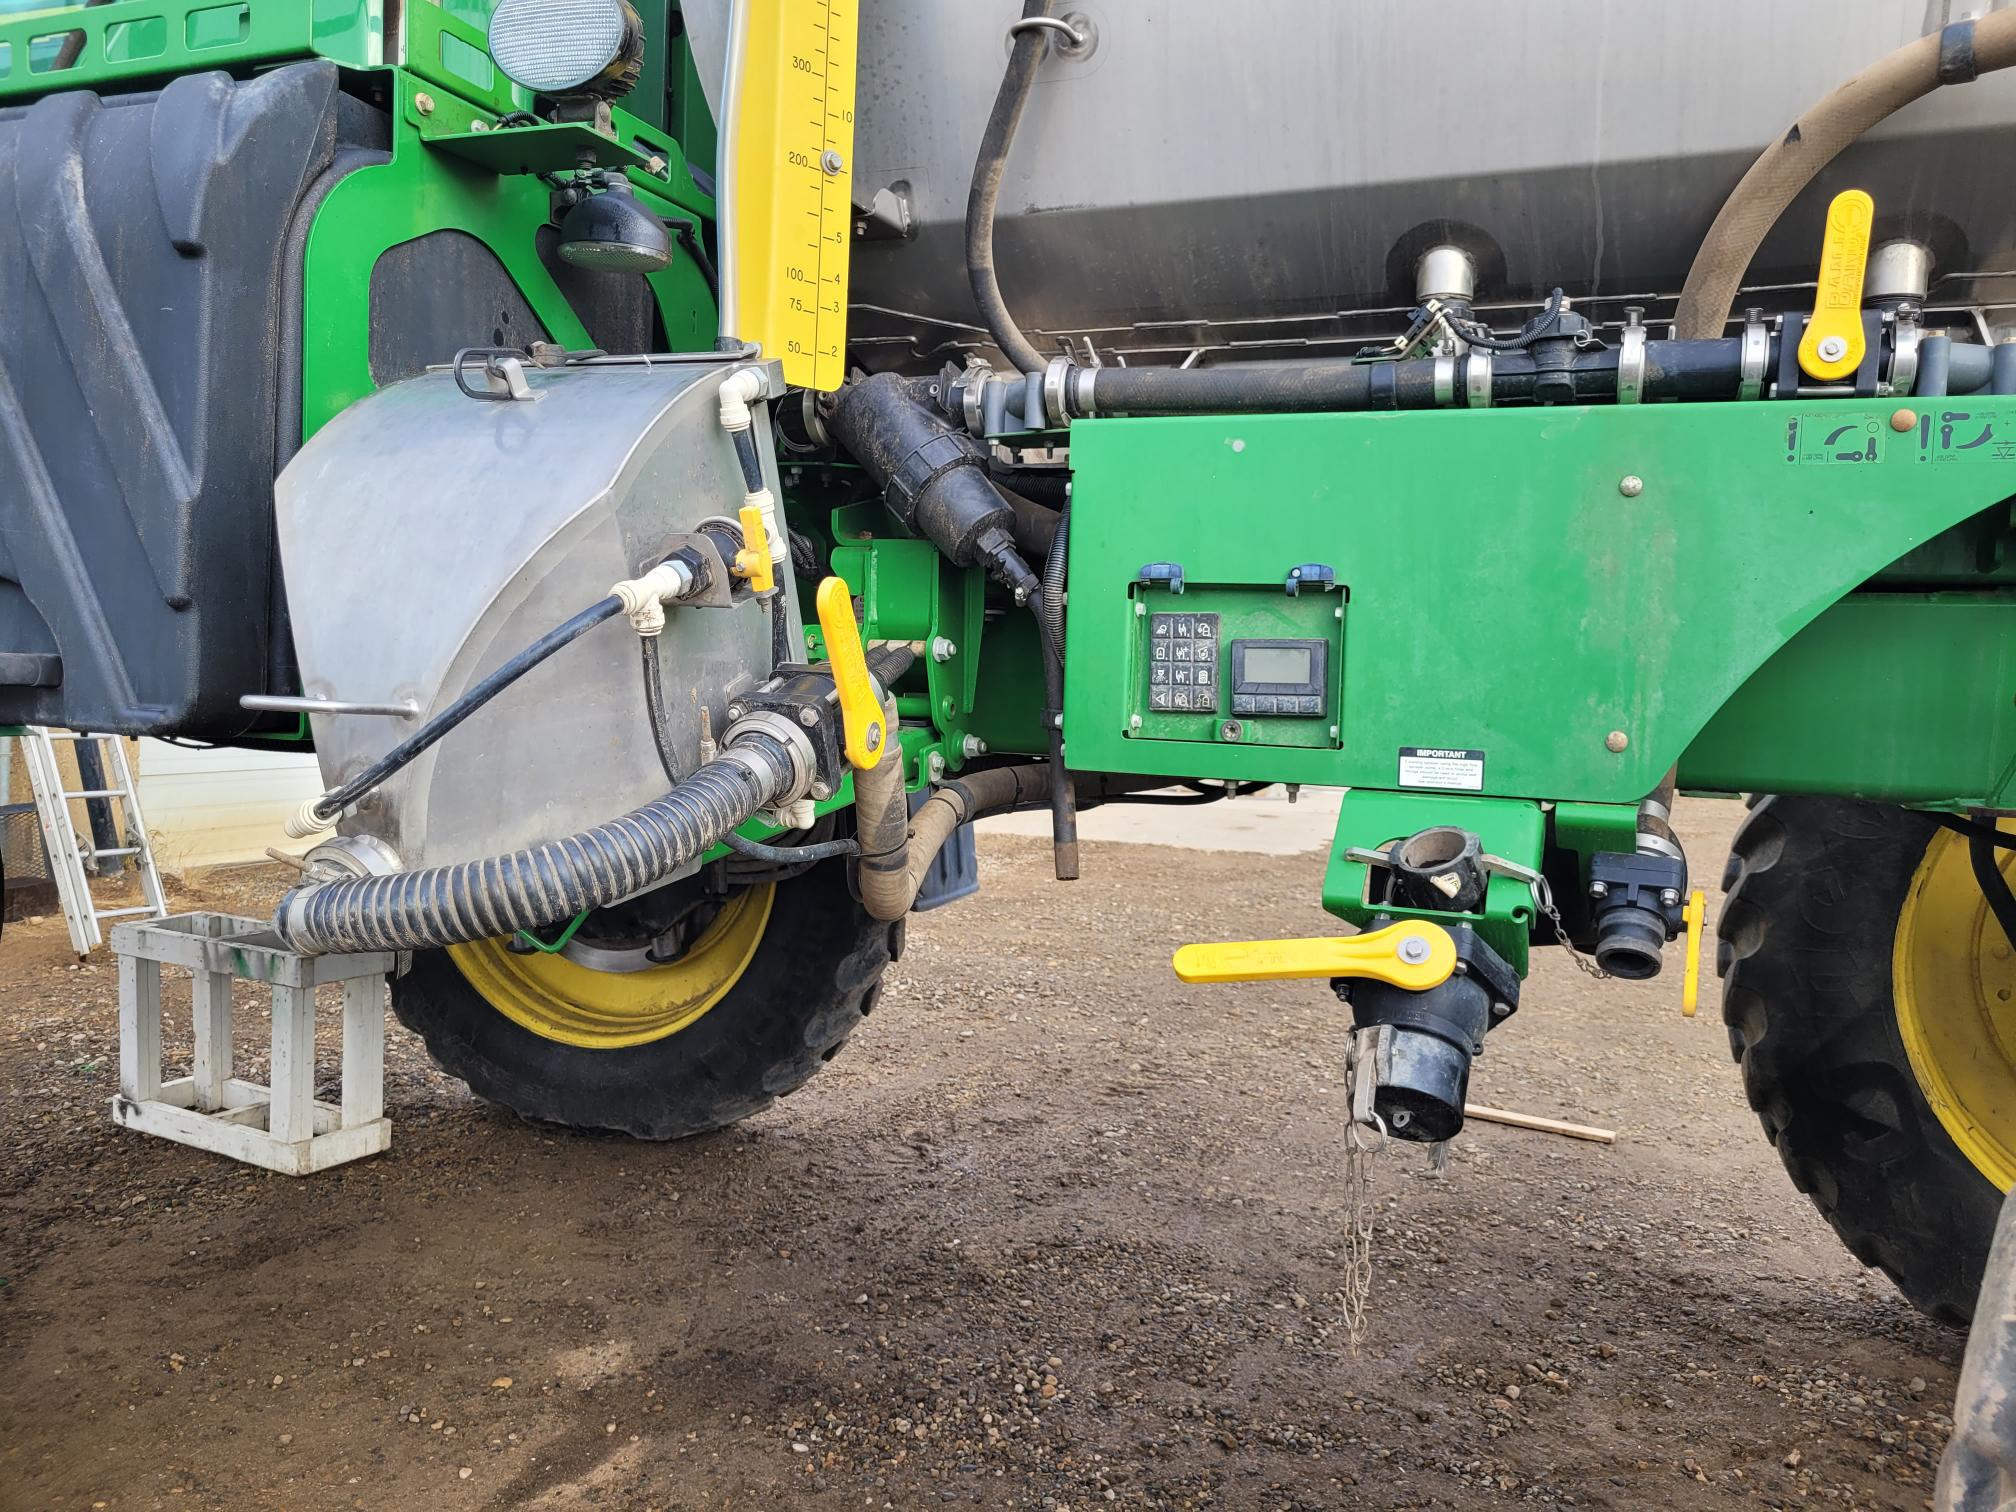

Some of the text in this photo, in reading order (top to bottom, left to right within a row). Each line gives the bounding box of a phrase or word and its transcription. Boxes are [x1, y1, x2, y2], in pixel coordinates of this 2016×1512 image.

[792, 56, 812, 73] 300
[841, 109, 853, 123] 10
[788, 151, 808, 167] 200
[835, 232, 842, 244] 5
[786, 266, 804, 282] 100
[834, 273, 841, 285] 4
[789, 297, 802, 312] 75
[833, 301, 840, 313] 3
[787, 340, 801, 354] 50
[831, 345, 838, 357] 2
[1416, 749, 1467, 759] IMPORTANT
